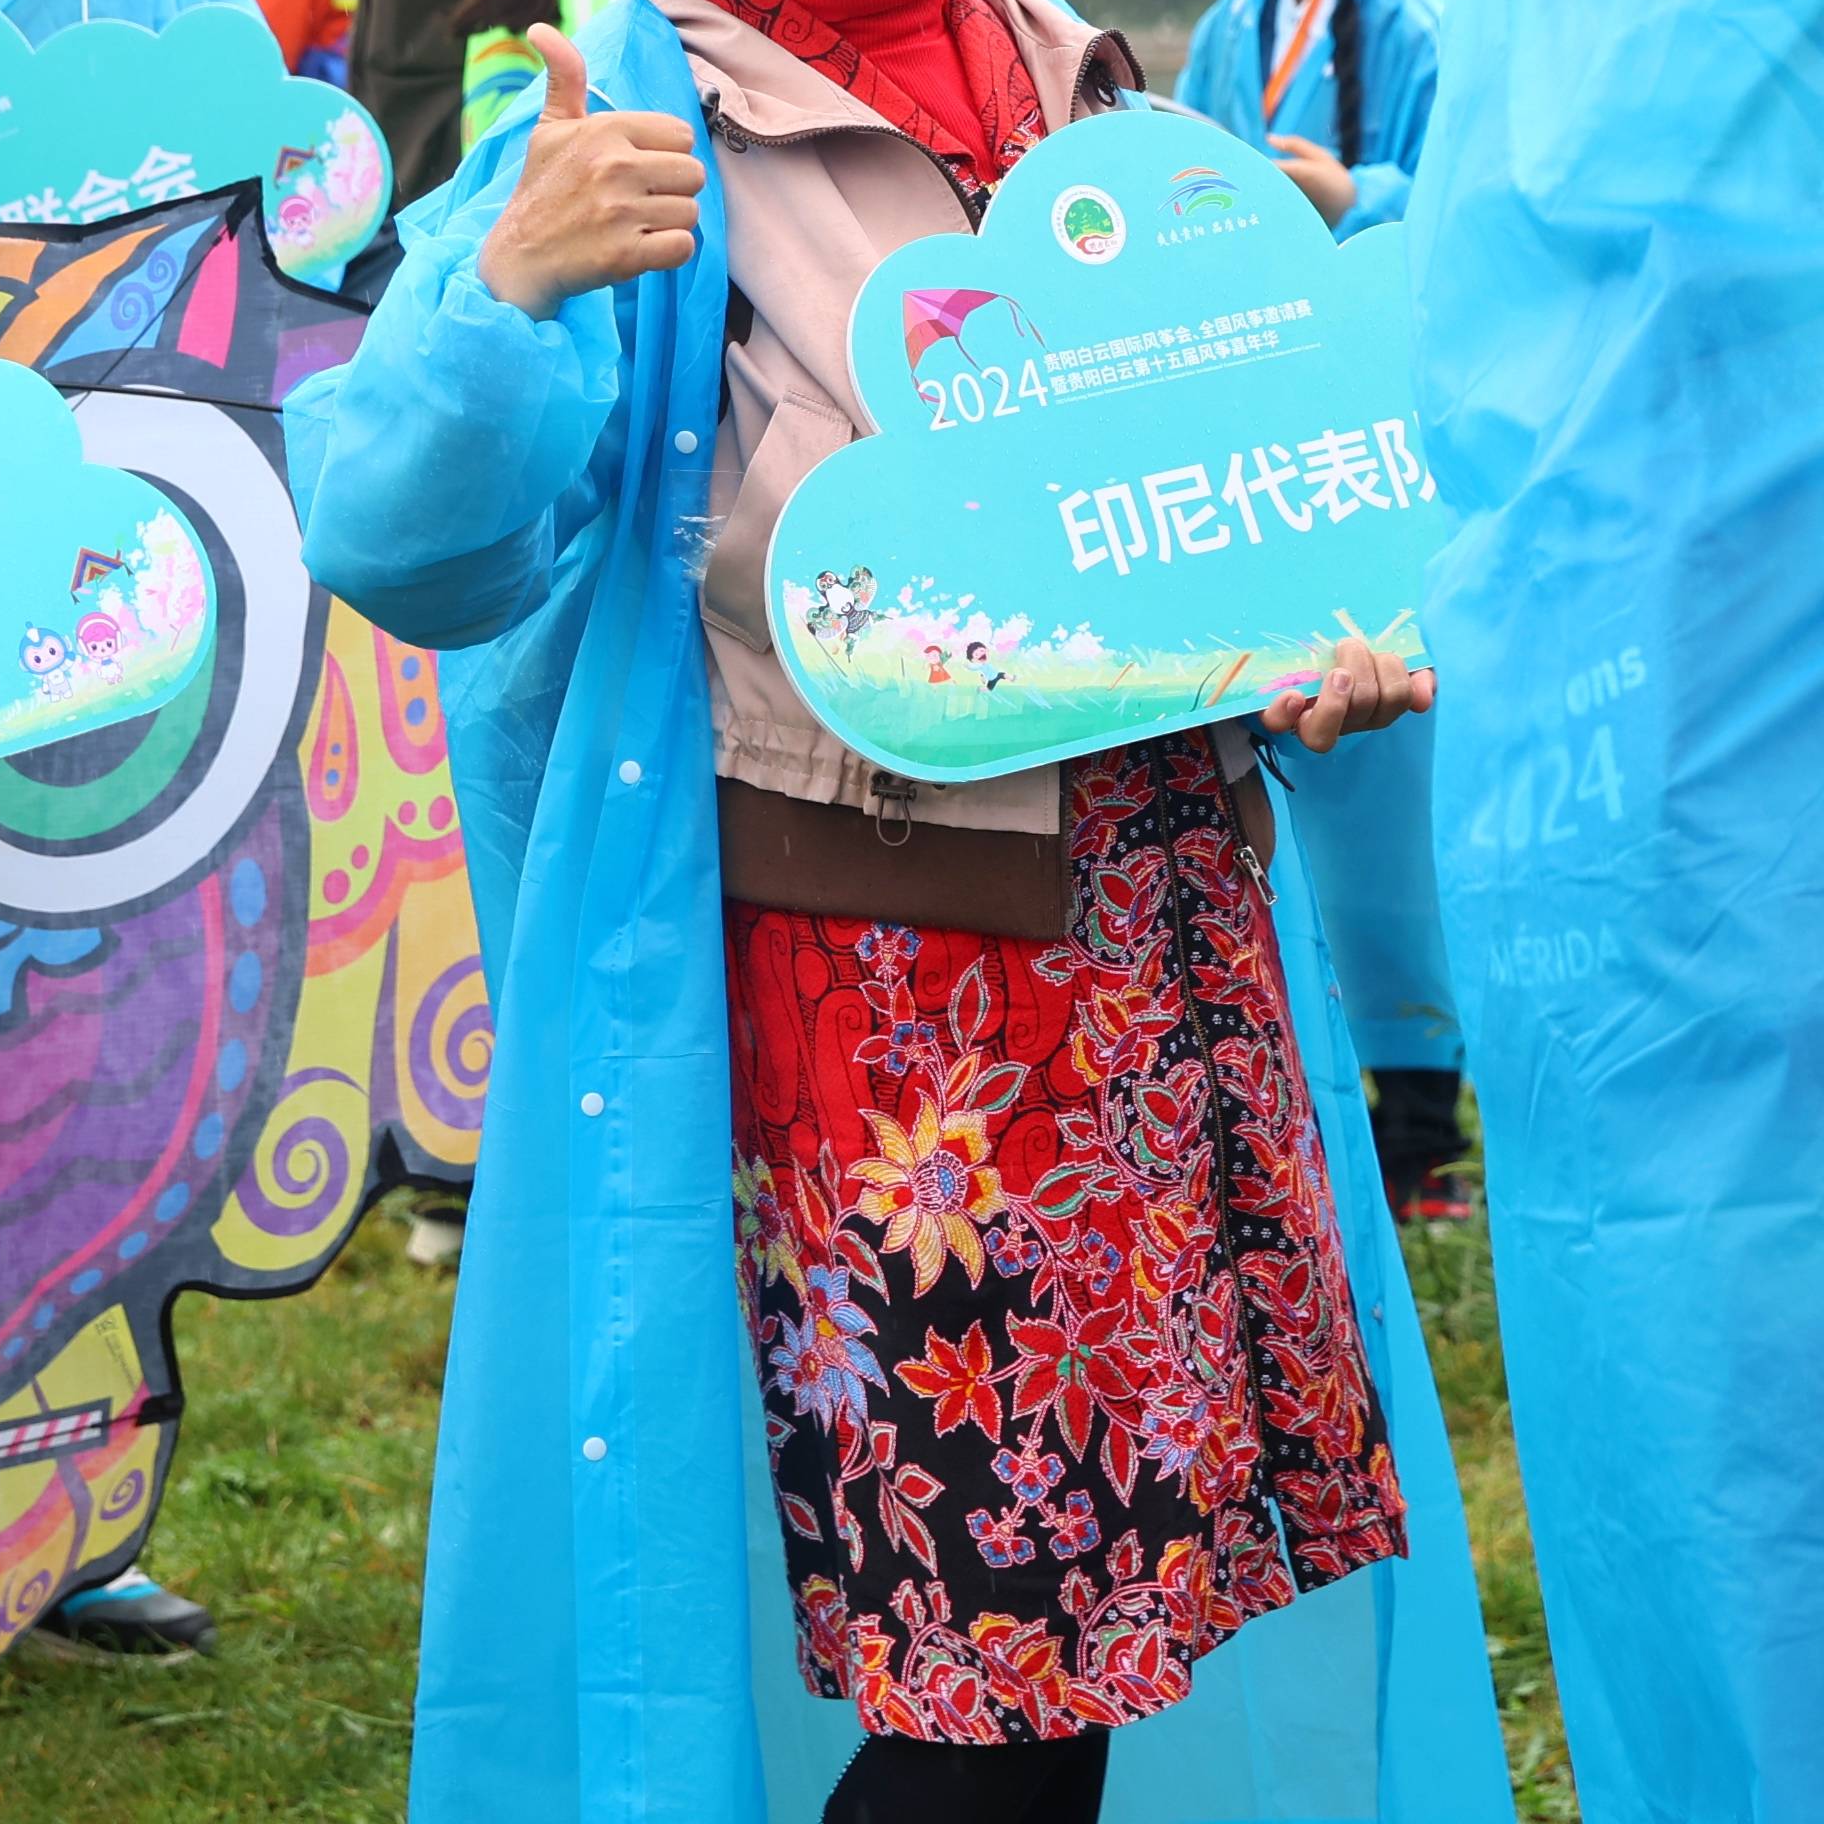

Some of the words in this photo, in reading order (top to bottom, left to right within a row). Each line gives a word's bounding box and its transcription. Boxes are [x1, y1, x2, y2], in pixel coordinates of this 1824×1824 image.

[1043, 298, 1313, 373] 贵阳白云国际风筝会、全国风筝邀请赛
[1050, 330, 1280, 397] 暨贵阳白云第十五届风筝嘉年华
[927, 355, 1049, 430] 2024
[1059, 409, 1437, 578] 印尼代表队
[1487, 920, 1621, 987] MÉRIDA
